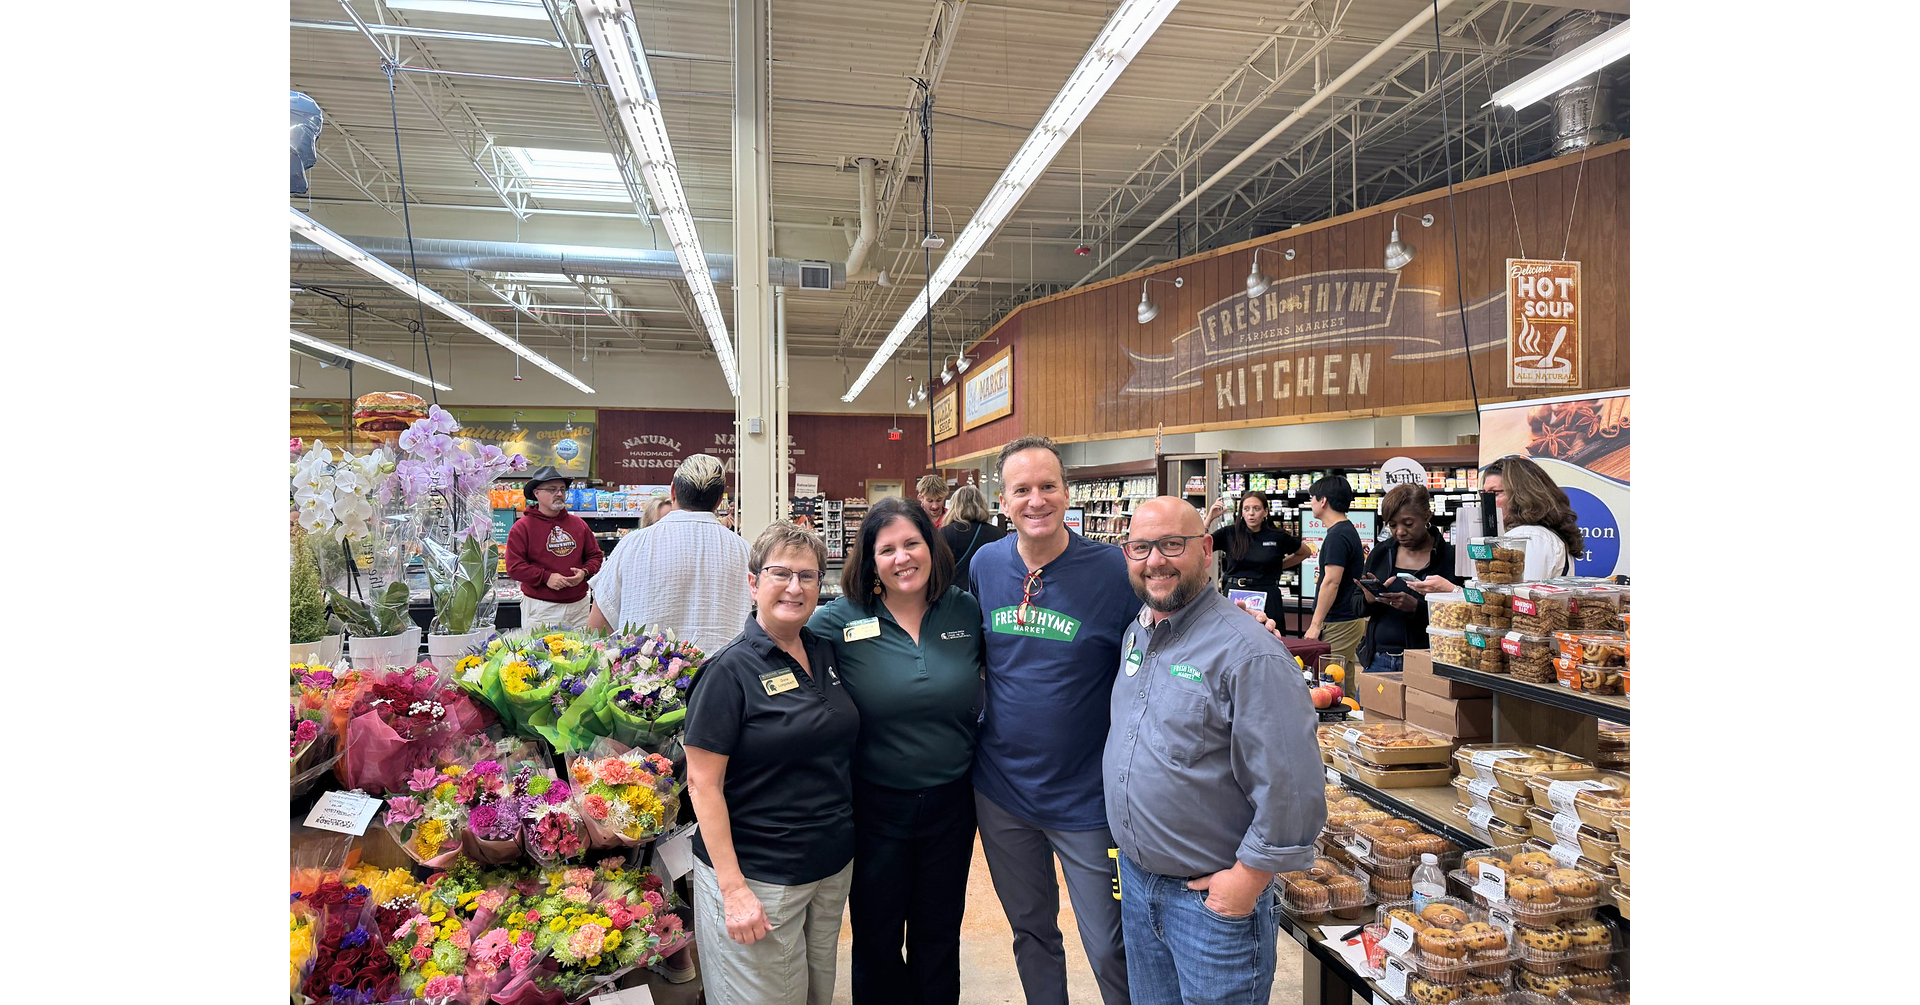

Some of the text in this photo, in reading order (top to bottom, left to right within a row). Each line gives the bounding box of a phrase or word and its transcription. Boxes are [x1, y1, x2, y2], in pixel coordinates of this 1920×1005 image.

[1511, 264, 1552, 278] Delicious
[1517, 276, 1574, 300] HOT
[1206, 281, 1388, 342] FRESH THYME
[1524, 300, 1574, 318] SOUP
[1239, 317, 1345, 343] FARMERS MARKET
[1215, 353, 1372, 410] KITCHEN
[1535, 373, 1575, 381] NATURAL
[622, 434, 683, 452] NATURAL
[621, 459, 681, 469] SAUSAGE
[1309, 521, 1319, 529] $6
[1013, 625, 1045, 634] MARKET
[1030, 609, 1075, 636] THYME
[1173, 665, 1187, 673] FRESH
[1177, 672, 1195, 680] MARKET
